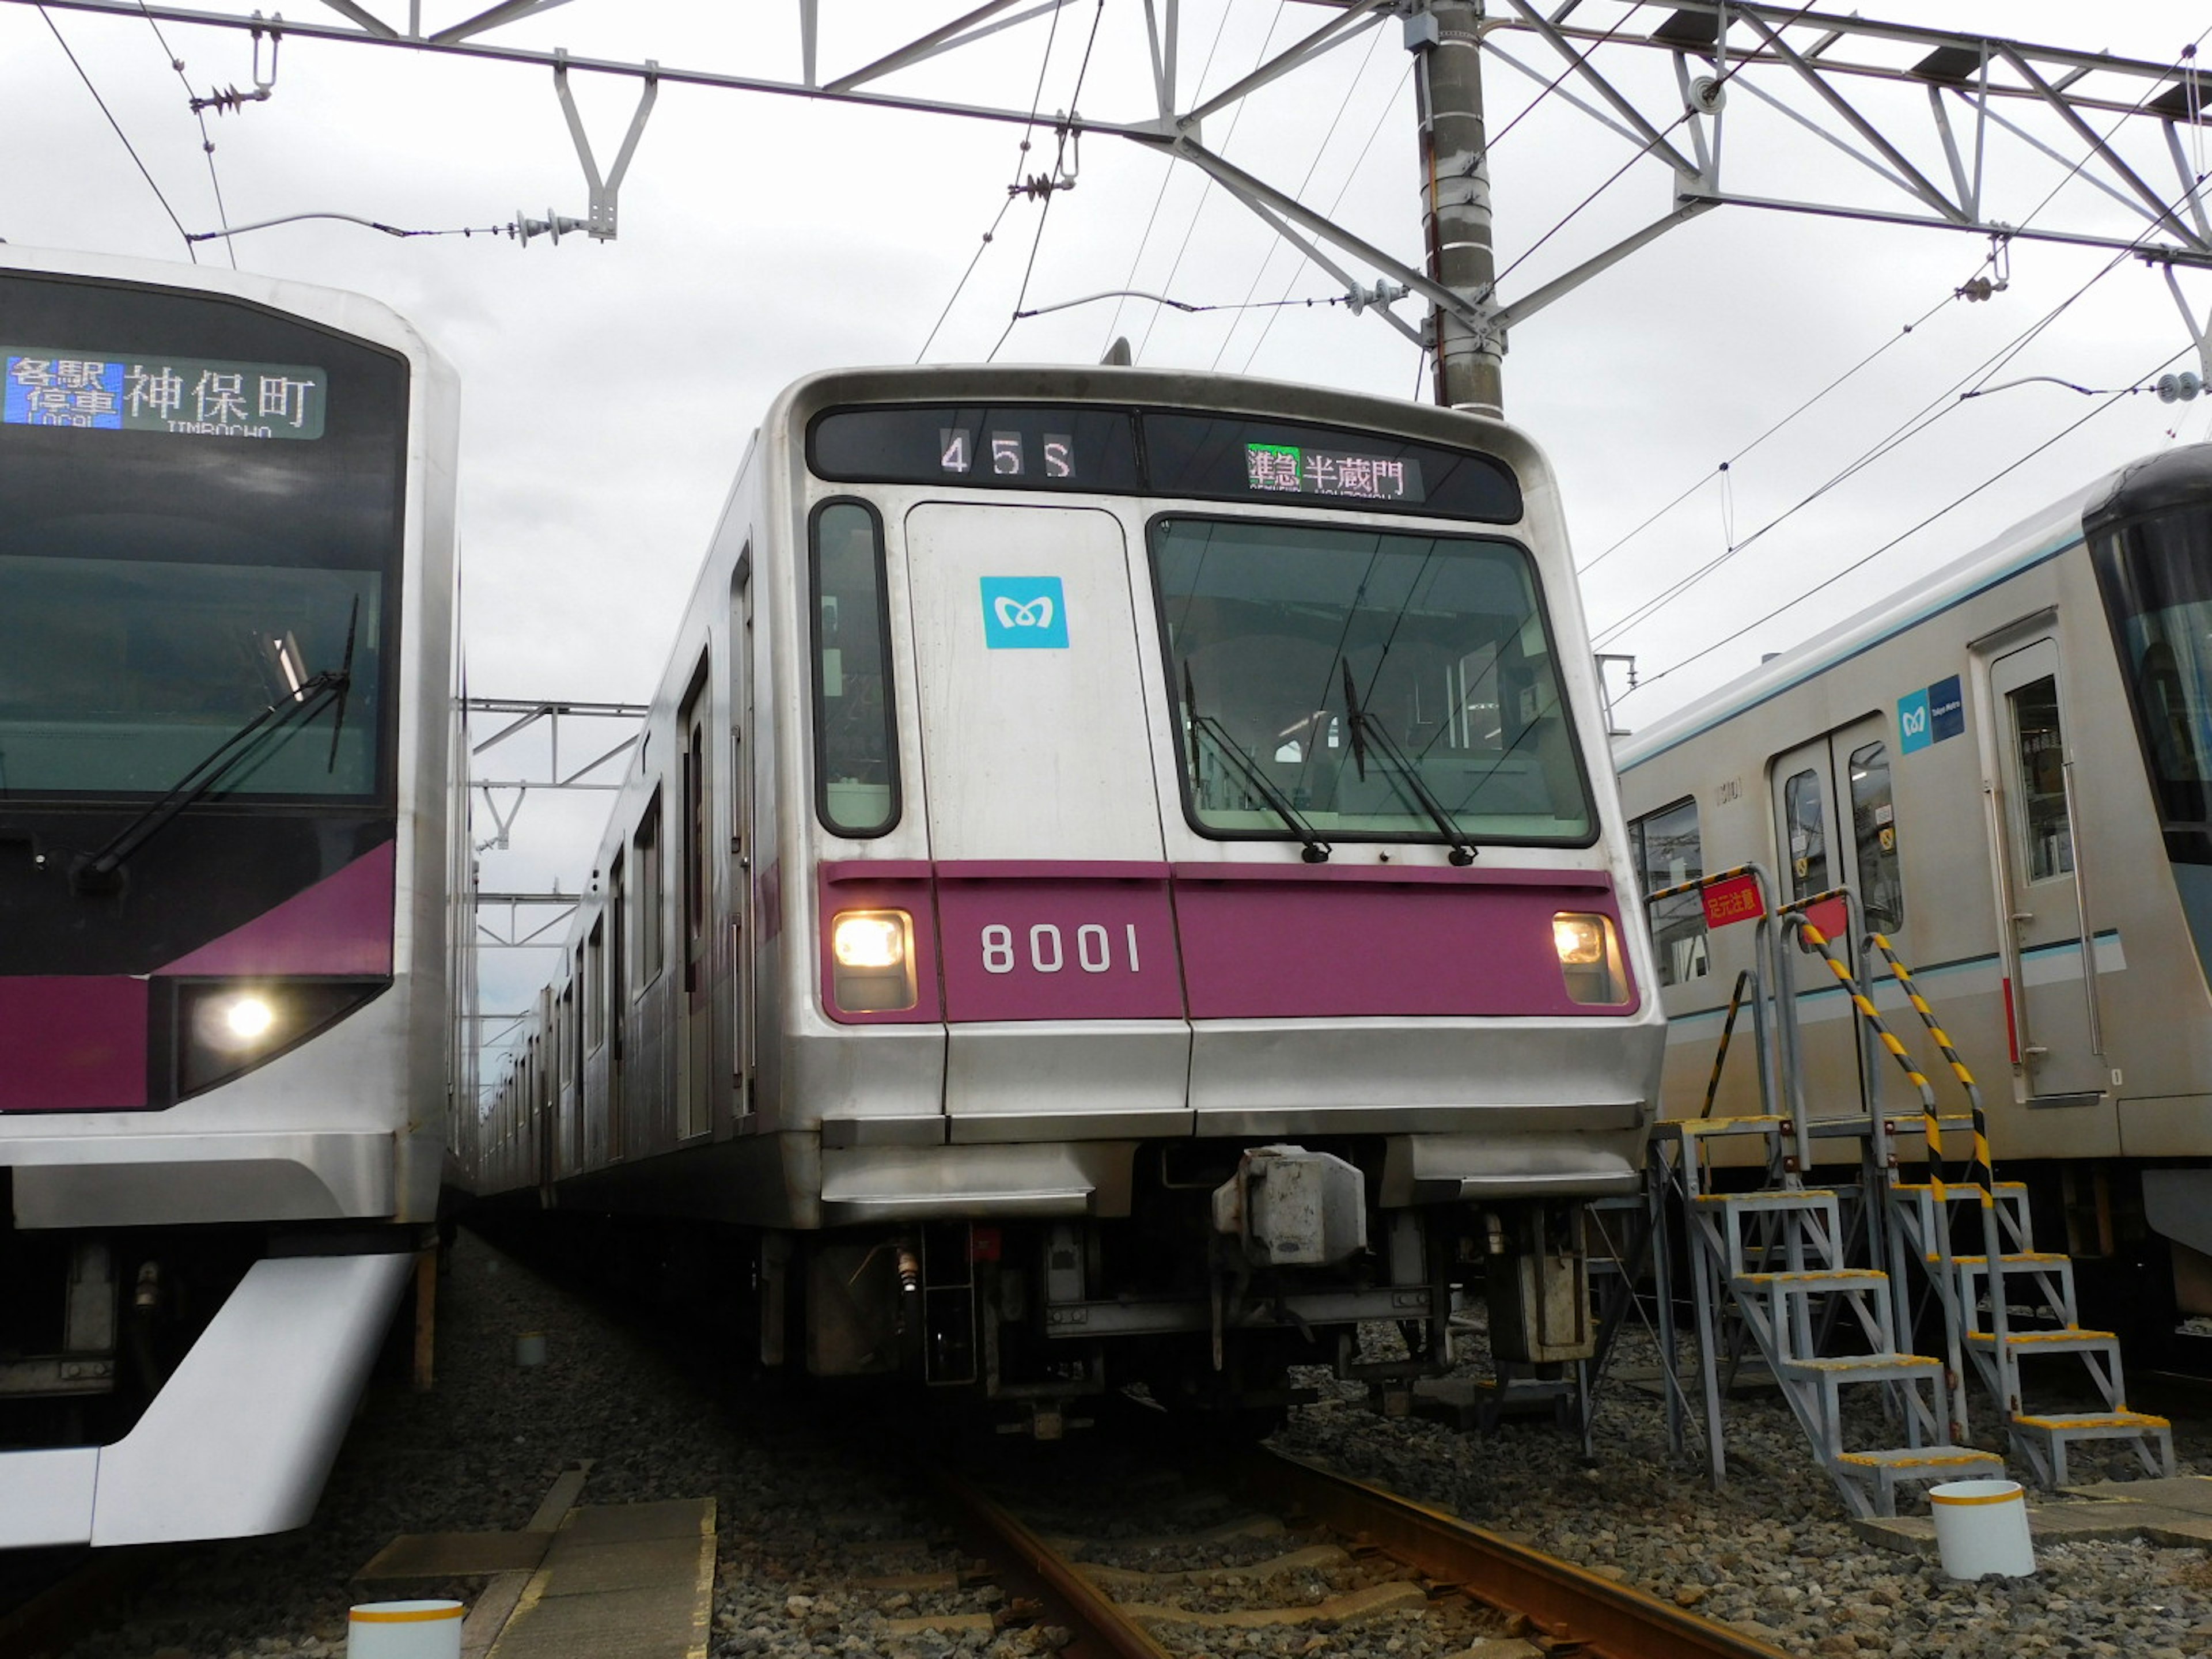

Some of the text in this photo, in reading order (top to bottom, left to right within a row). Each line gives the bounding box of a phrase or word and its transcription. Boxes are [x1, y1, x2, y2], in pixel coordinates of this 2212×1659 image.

[10, 357, 104, 389] 各駅
[27, 386, 117, 415] 停車
[123, 363, 316, 428] 神保町
[1248, 449, 1301, 487] 準急
[1303, 454, 1404, 497] 半蔵門
[1707, 888, 1756, 920] 足元注意
[981, 923, 1140, 974] 8001
